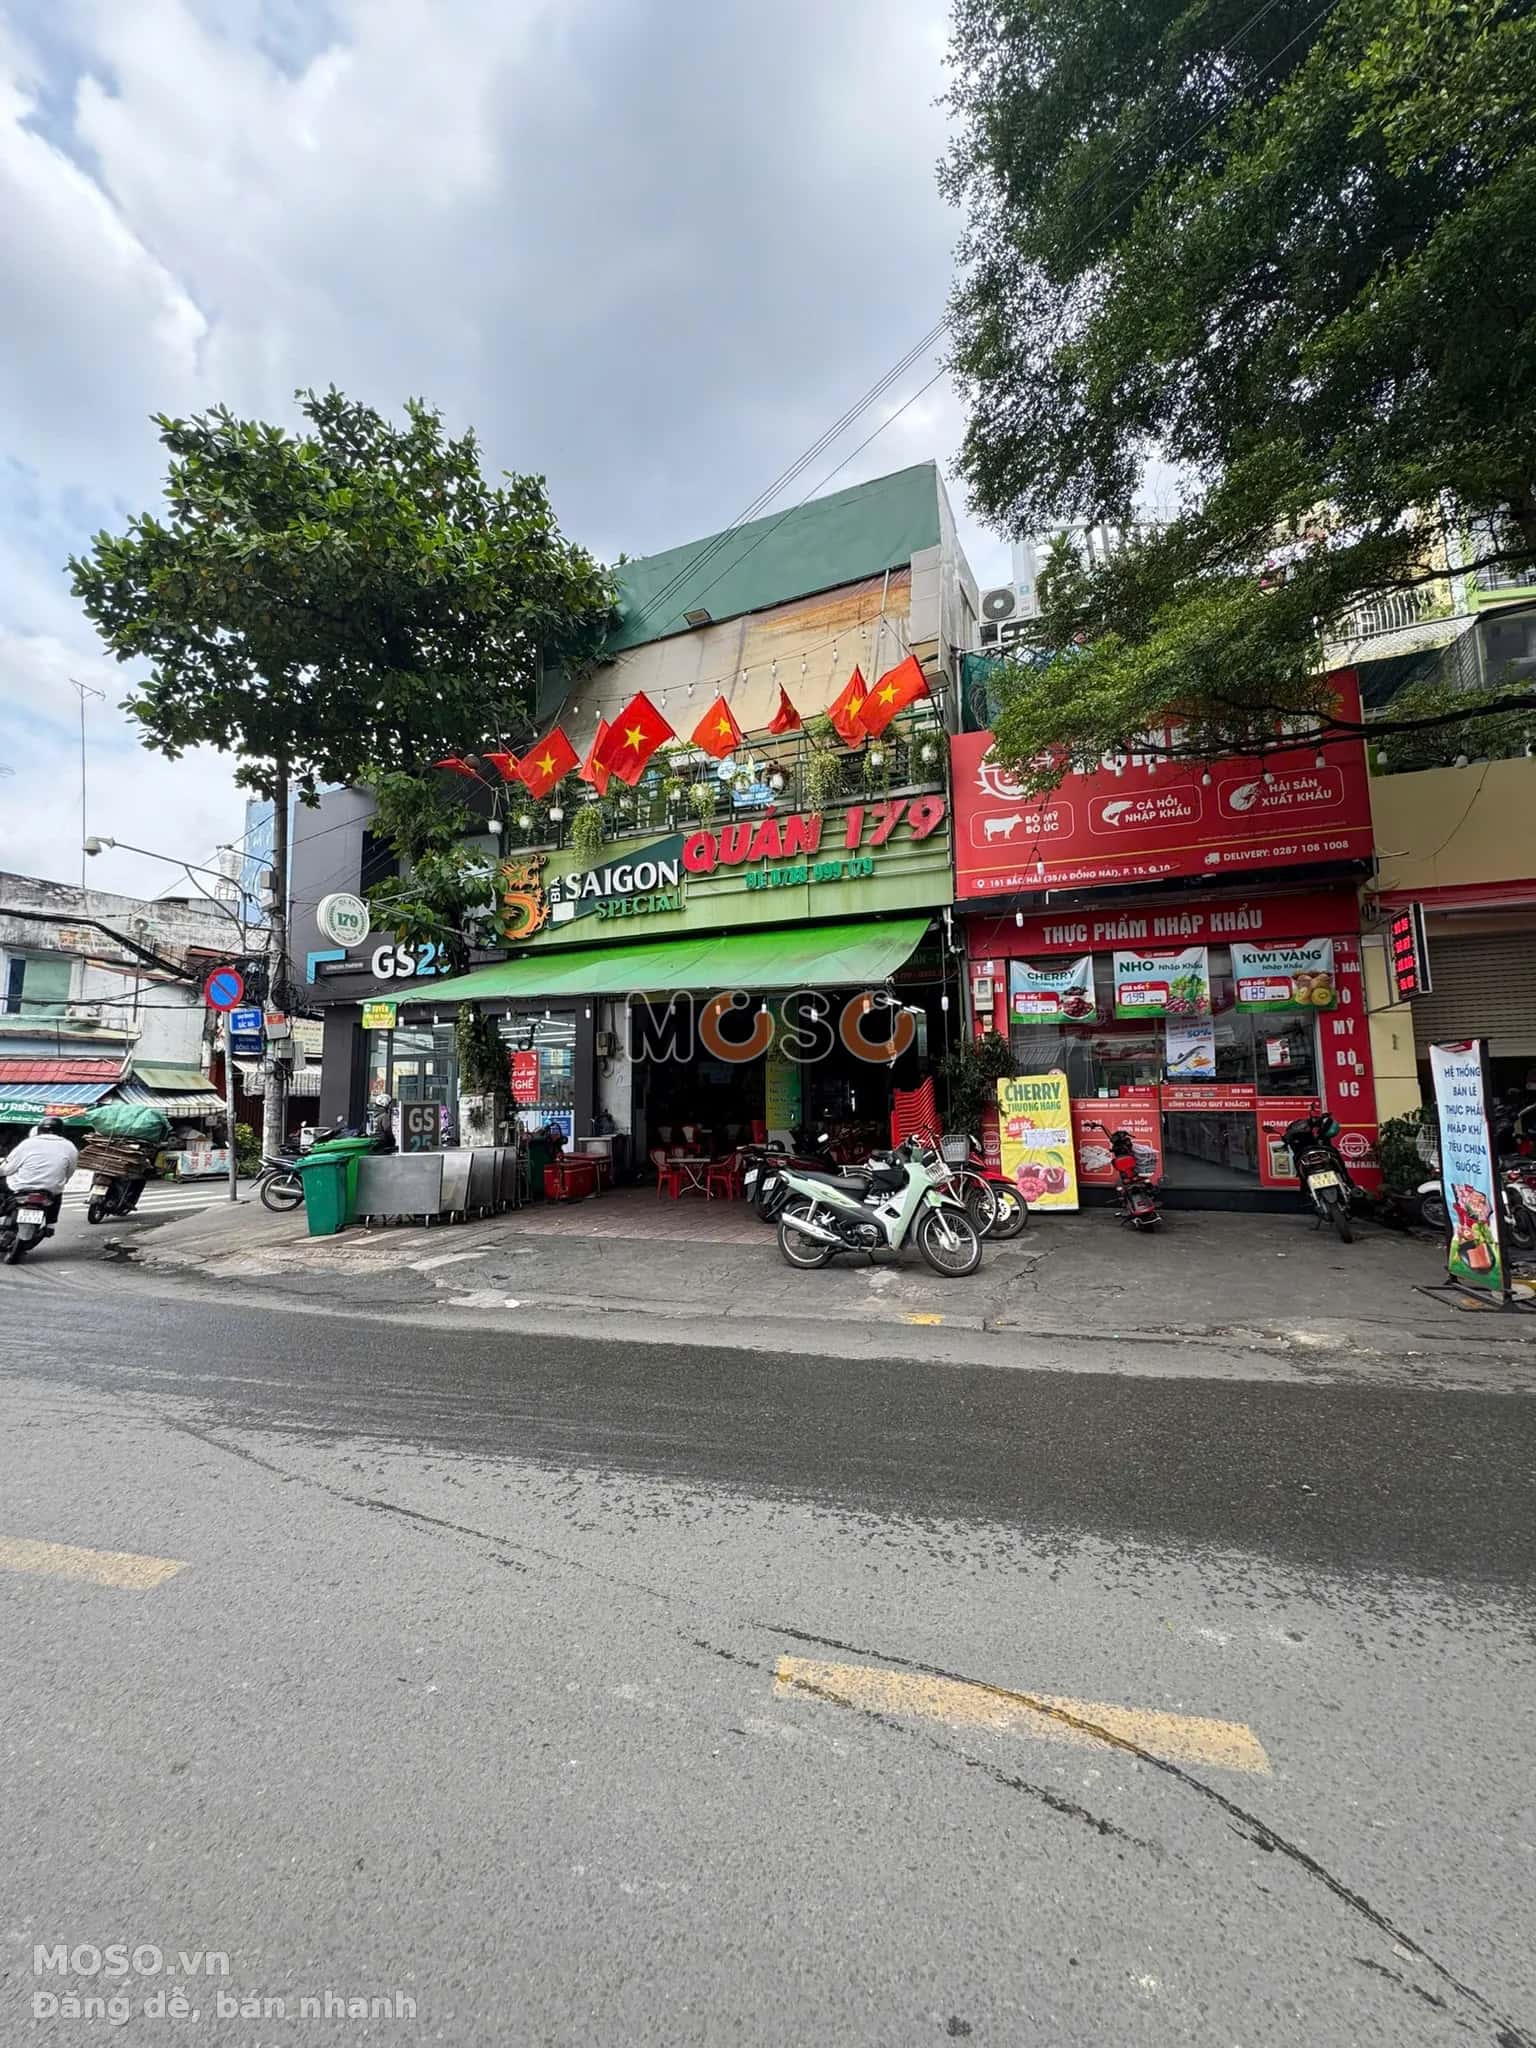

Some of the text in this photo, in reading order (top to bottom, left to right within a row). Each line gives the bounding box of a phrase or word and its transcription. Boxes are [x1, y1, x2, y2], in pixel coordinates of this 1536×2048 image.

[1293, 776, 1318, 790] SẢN
[1136, 798, 1154, 810] CÁ
[1261, 792, 1293, 807] XUẤT
[1025, 810, 1059, 825] BÒ MỸ
[1125, 803, 1192, 824] NHẬP KHẨU
[681, 794, 946, 874] QUÁN 179
[1223, 849, 1271, 862] DELIVERY:
[1323, 840, 1350, 850] 1008
[564, 858, 679, 900] SAIGON
[550, 875, 561, 902] BIA
[595, 890, 686, 919] SPECIAL
[1043, 902, 1264, 947] THỰC PHẨM NHẬP KHẨU
[1242, 950, 1323, 964] KIWI VÀNG
[1027, 969, 1076, 981] CHERRY
[1119, 960, 1155, 973] NHO
[1333, 1017, 1355, 1035] MỸ
[1336, 1048, 1357, 1066] BÒ
[1456, 1063, 1481, 1078] THỐNG
[1004, 1082, 1061, 1102] CHERRY
[1339, 1080, 1361, 1097] ÚC
[408, 1107, 434, 1133] GS
